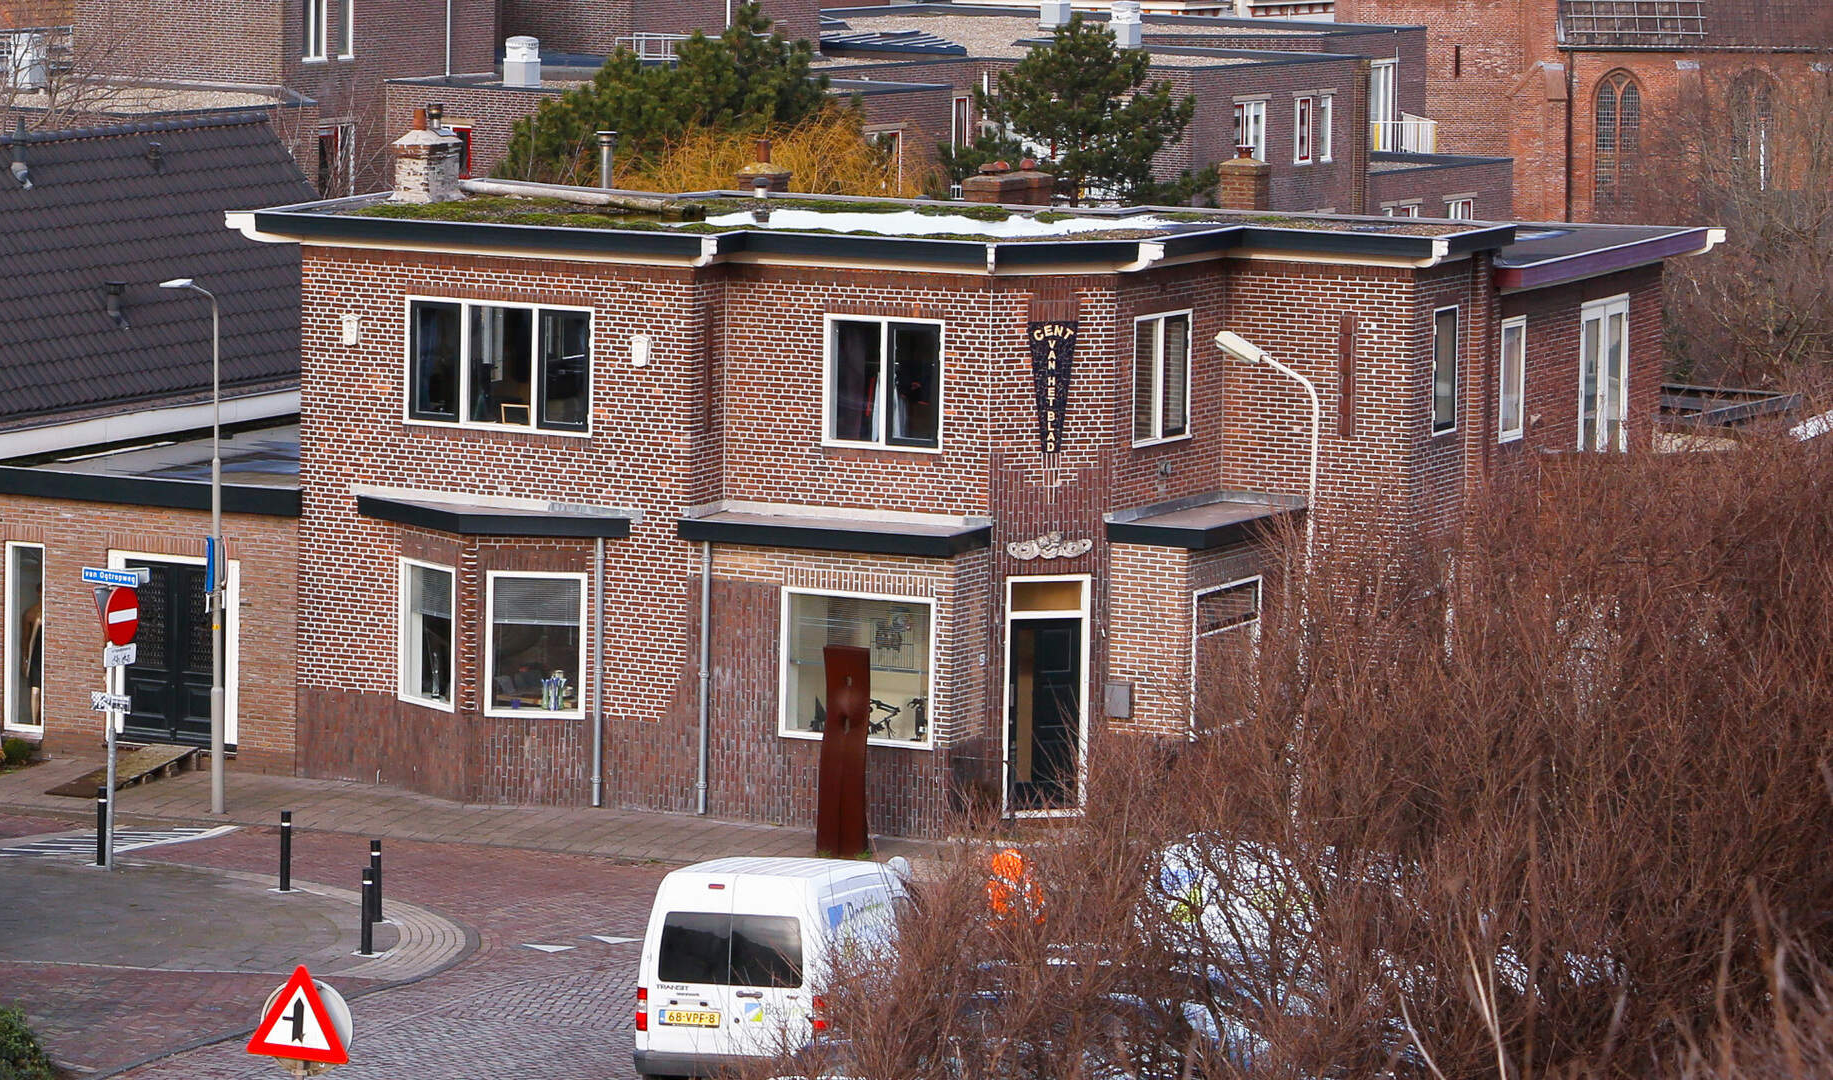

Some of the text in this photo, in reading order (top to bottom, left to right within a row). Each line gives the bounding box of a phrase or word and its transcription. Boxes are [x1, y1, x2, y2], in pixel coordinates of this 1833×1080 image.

[1047, 340, 1056, 370] VAN
[1047, 377, 1056, 407] HET
[1046, 411, 1056, 452] BLAD
